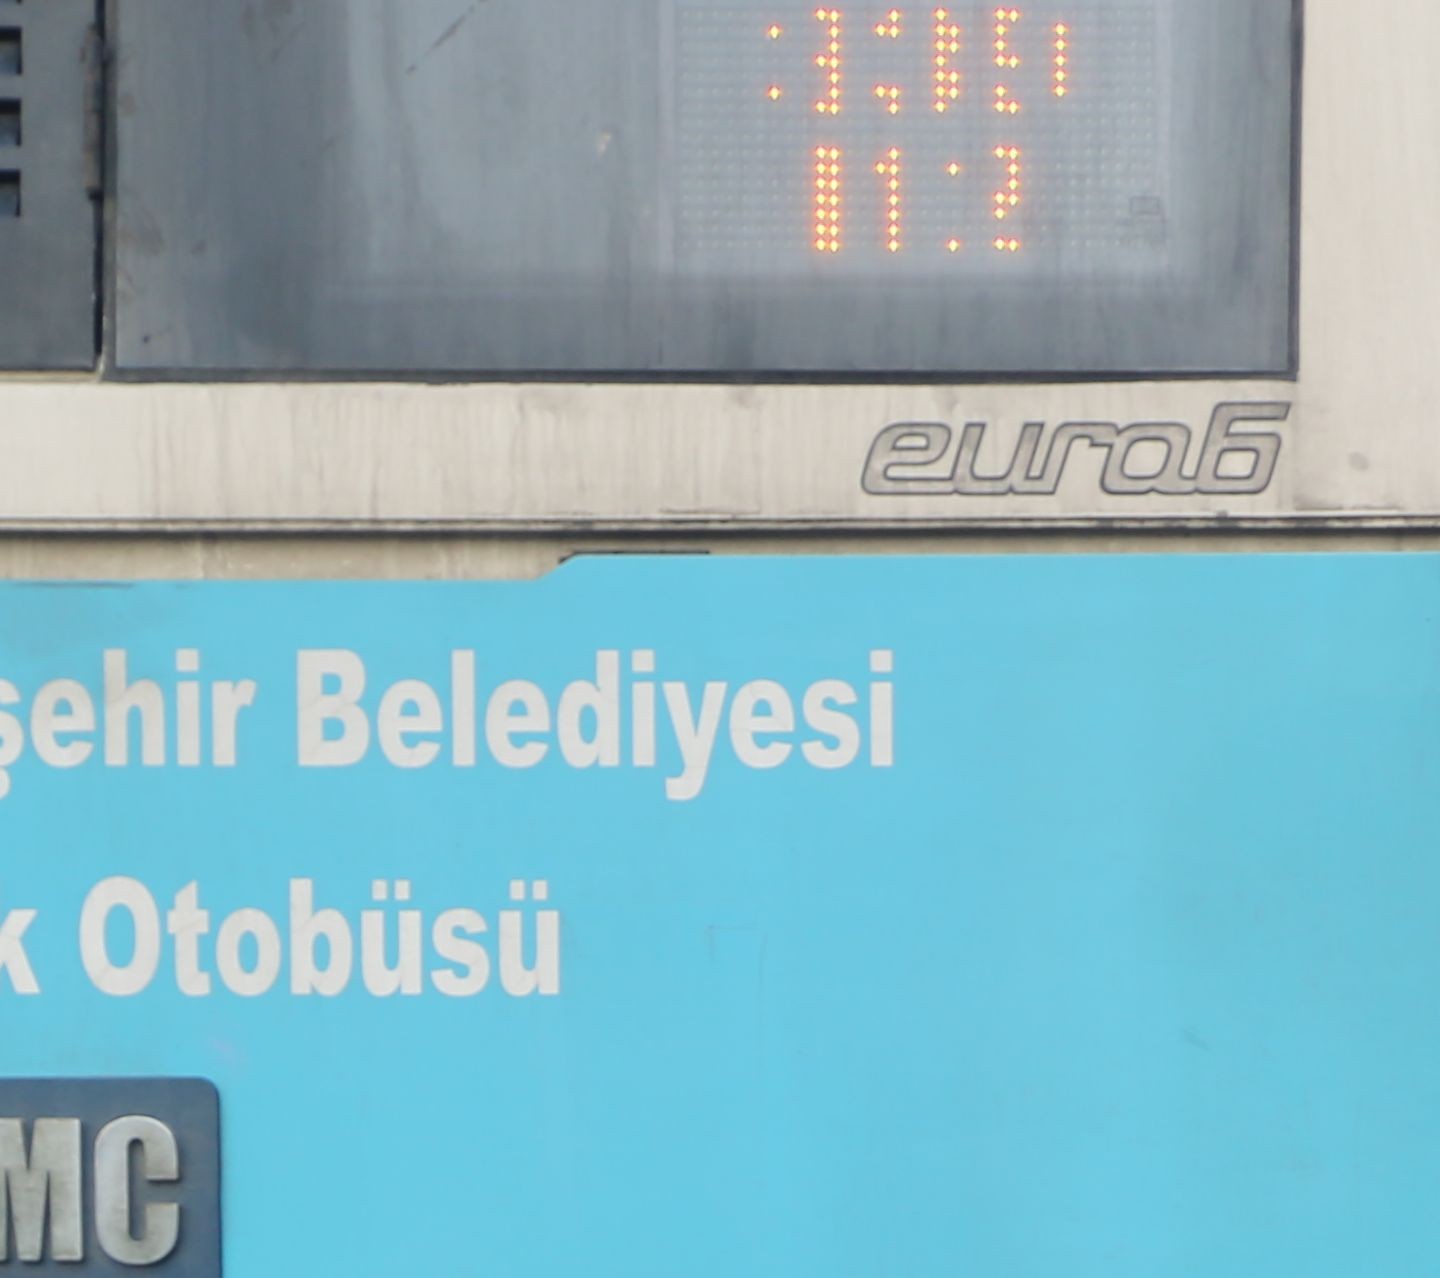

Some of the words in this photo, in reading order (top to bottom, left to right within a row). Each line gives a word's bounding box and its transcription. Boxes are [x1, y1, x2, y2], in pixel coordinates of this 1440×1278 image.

[861, 401, 1291, 495] euro6
[297, 649, 894, 801] Belediyesi
[79, 875, 562, 997] Otobüsü
